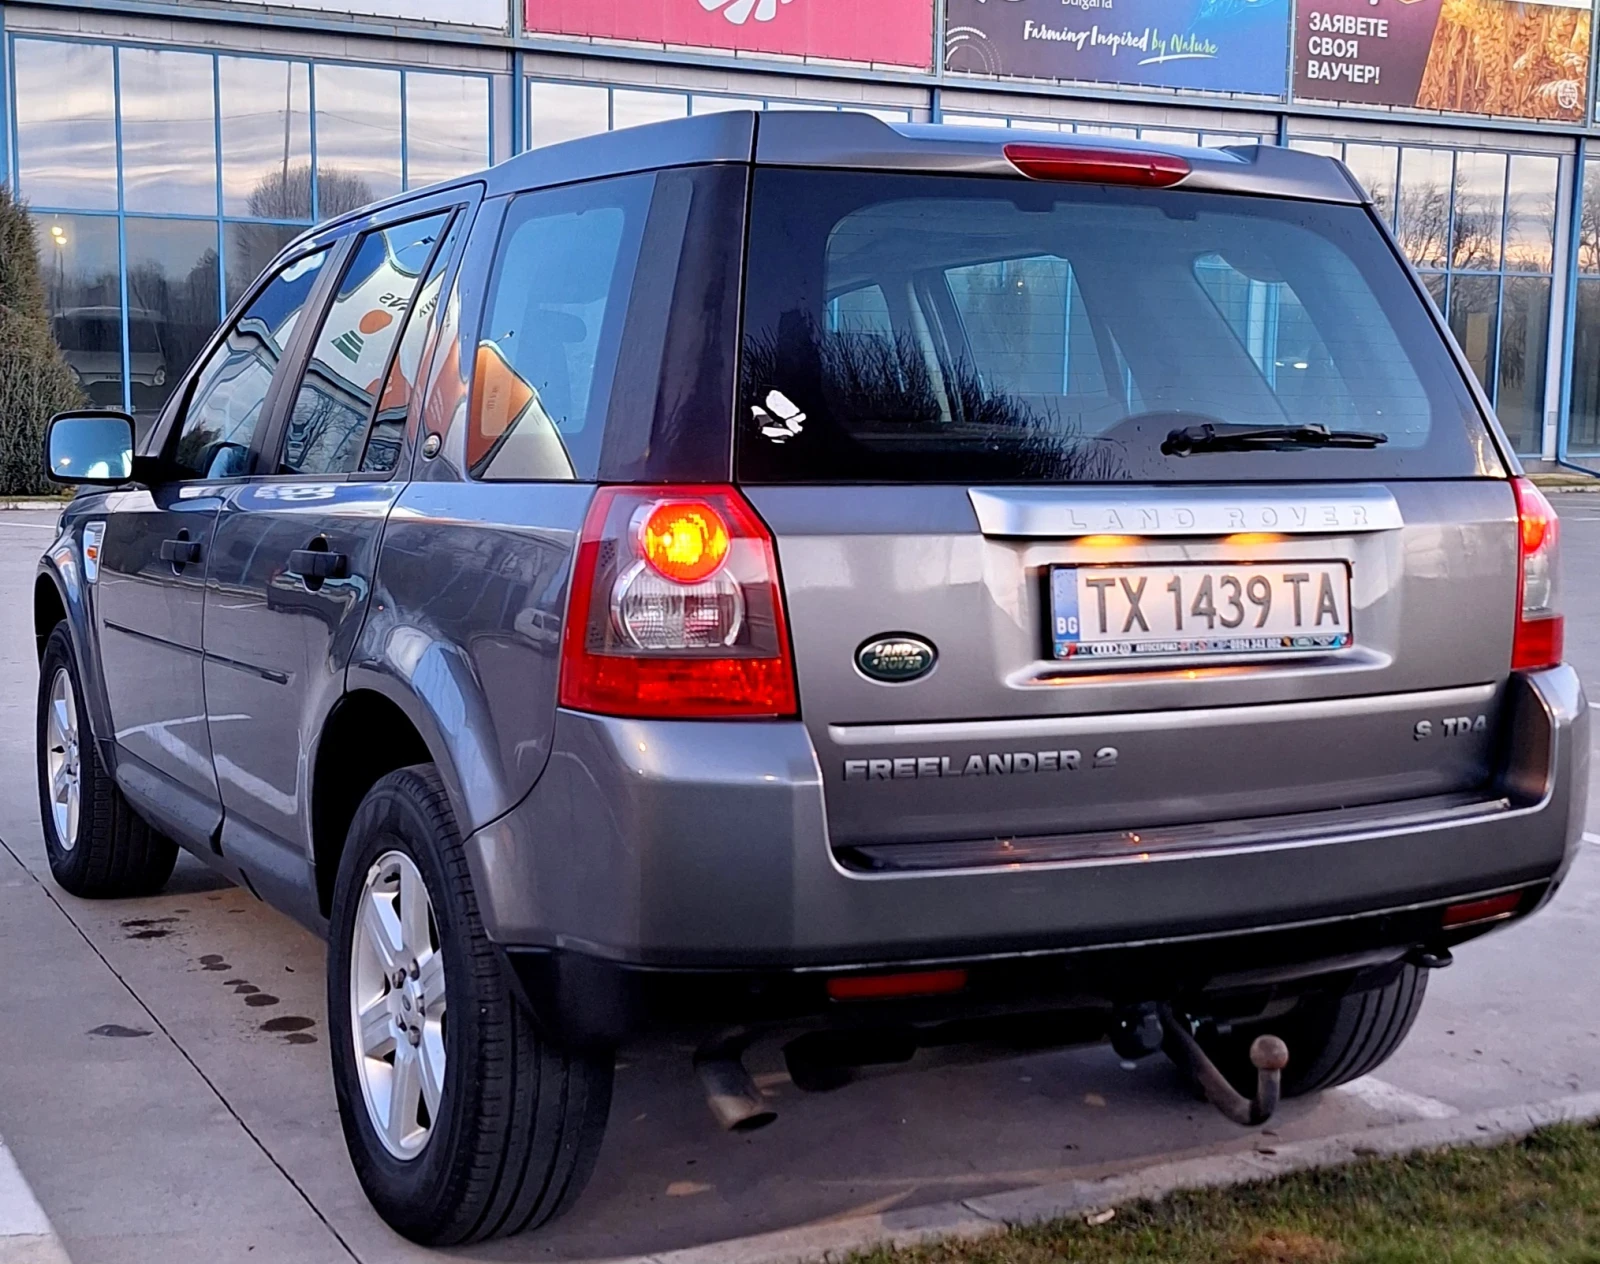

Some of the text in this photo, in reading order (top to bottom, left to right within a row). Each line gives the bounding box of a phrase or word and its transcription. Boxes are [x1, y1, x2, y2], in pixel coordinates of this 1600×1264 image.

[1309, 11, 1389, 38] ЗАЯВЕТЕ
[1024, 20, 1218, 63] Farming Inspired by Nature
[1308, 36, 1359, 58] СВОЯ
[1307, 60, 1380, 85] ВАУЧЕР!
[1065, 505, 1370, 530] LAND ROVER
[1086, 572, 1341, 633] TX 1439 TA
[1057, 617, 1078, 635] BG
[1414, 714, 1486, 740] S TD4
[843, 747, 1119, 781] FREELANDER 2
